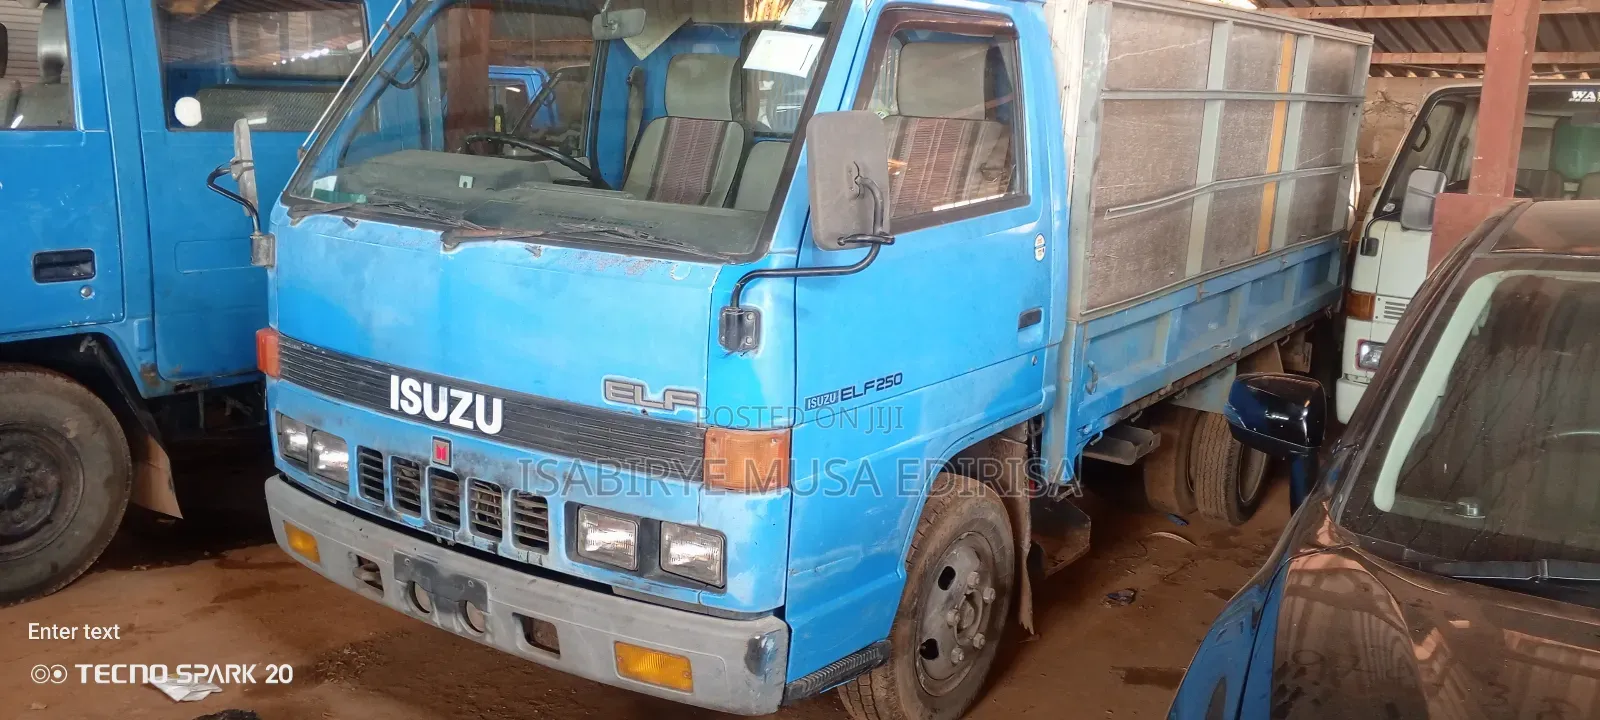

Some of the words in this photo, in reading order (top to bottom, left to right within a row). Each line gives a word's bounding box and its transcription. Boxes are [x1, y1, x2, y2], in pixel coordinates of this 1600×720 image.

[390, 374, 503, 435] ISUZU
[603, 378, 700, 411] ELF
[806, 391, 838, 410] ISUZU
